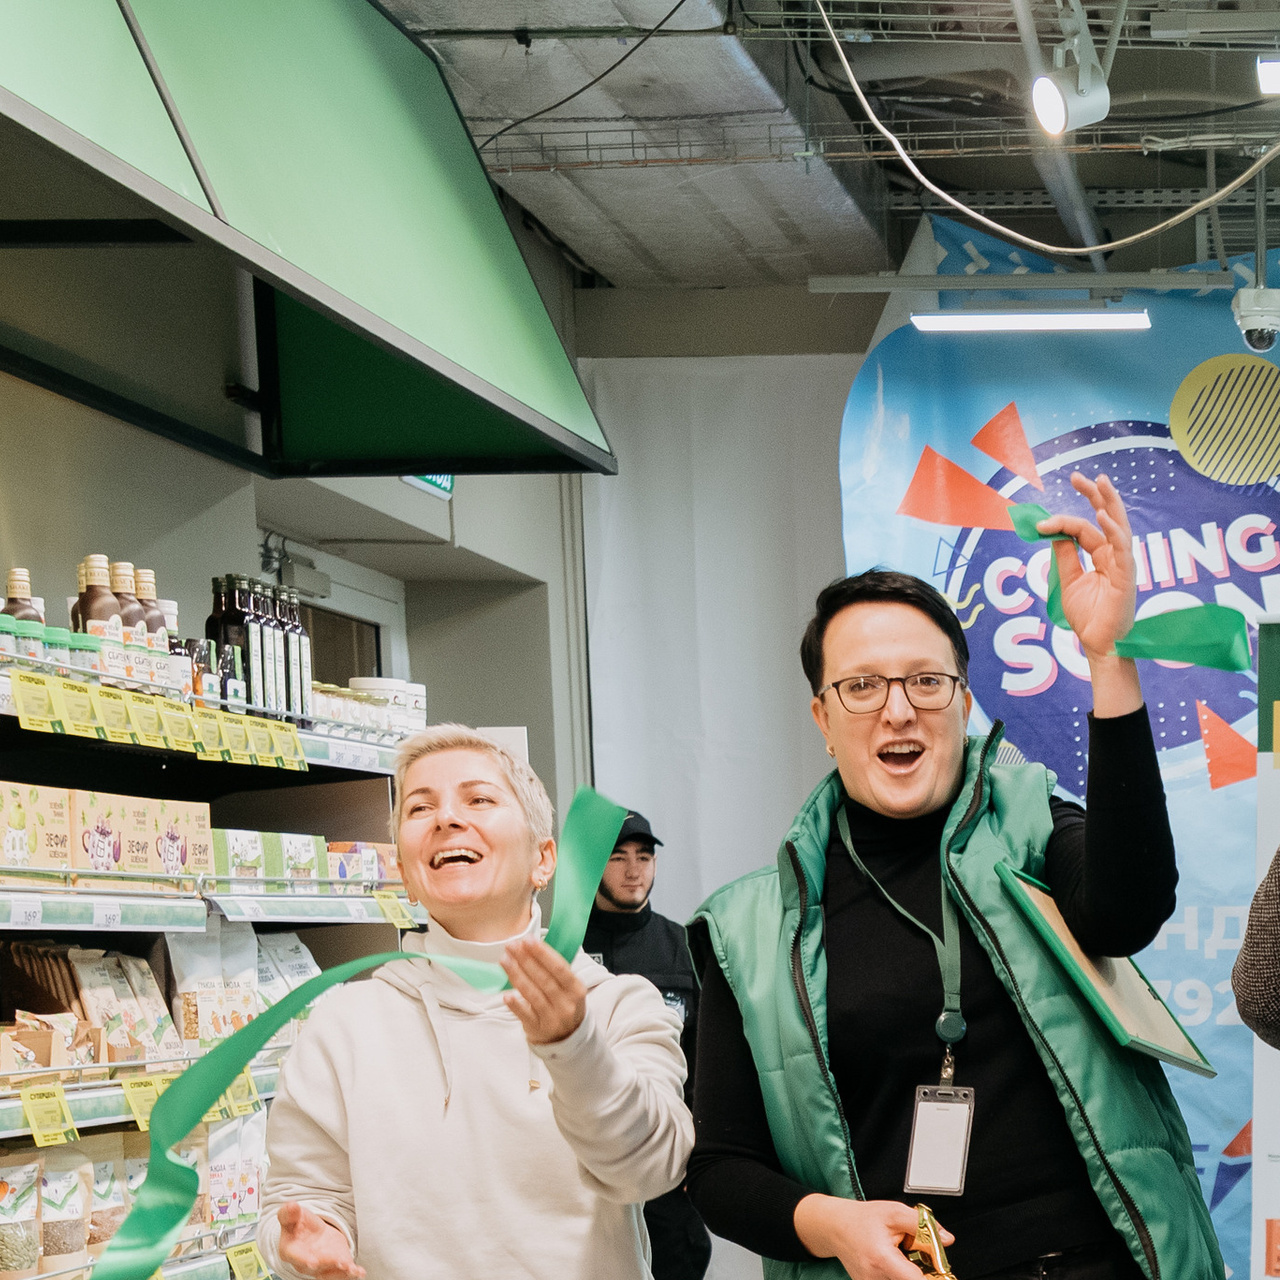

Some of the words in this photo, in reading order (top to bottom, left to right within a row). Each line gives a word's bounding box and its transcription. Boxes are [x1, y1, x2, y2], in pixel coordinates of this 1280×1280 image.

[19, 674, 46, 687] СУПЕРЦЕНА
[63, 682, 88, 694] СУПЕРЦЕНА
[99, 690, 123, 701] СУПЕРЦЕНА
[132, 695, 155, 706] СУПЕРЦЕНА
[163, 701, 186, 712] СУПЕРЦЕНА
[45, 833, 68, 848] ЗЕФИР
[127, 840, 149, 853] ЗЕФИР
[192, 844, 209, 856] ЗЕФИР
[24, 911, 37, 922] 169
[105, 913, 116, 924] 169
[130, 1081, 153, 1090] СУПЕРЦЕНА
[30, 1091, 56, 1101] СУПЕРЦЕНА
